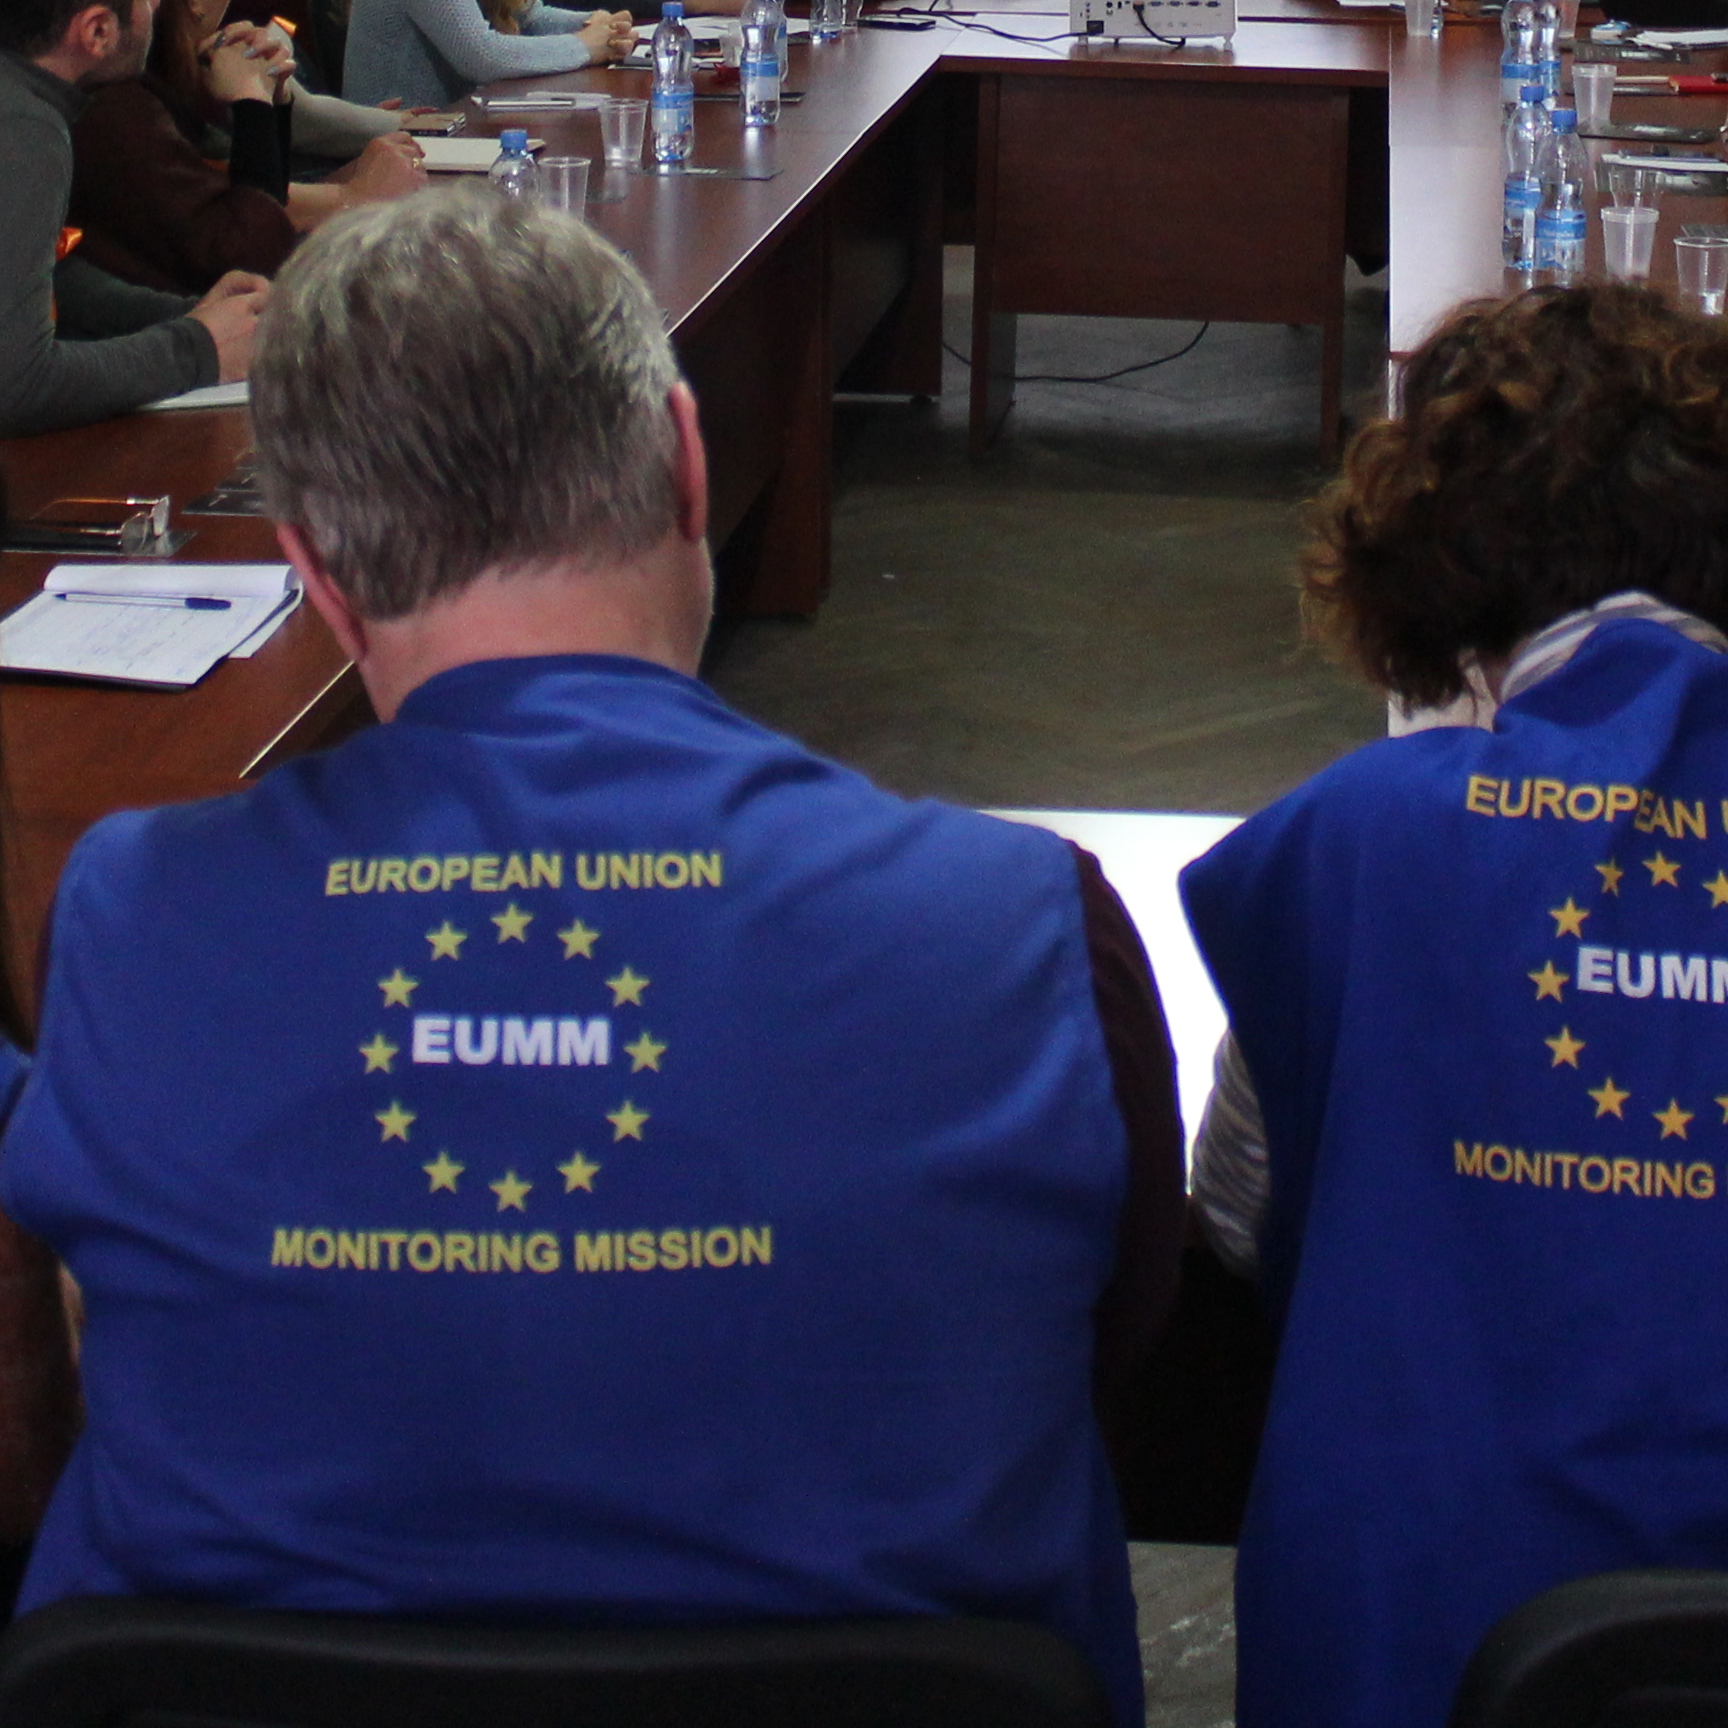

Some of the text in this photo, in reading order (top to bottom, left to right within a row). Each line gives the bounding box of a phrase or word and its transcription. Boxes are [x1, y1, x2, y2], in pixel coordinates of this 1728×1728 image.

[1465, 774, 1707, 840] EUROPEAN
[324, 850, 724, 896] EUROPEAN UNION
[411, 1015, 611, 1067] EUMM
[1453, 1139, 1715, 1200] MONITORING
[271, 1225, 772, 1273] MONITORING MISSION
